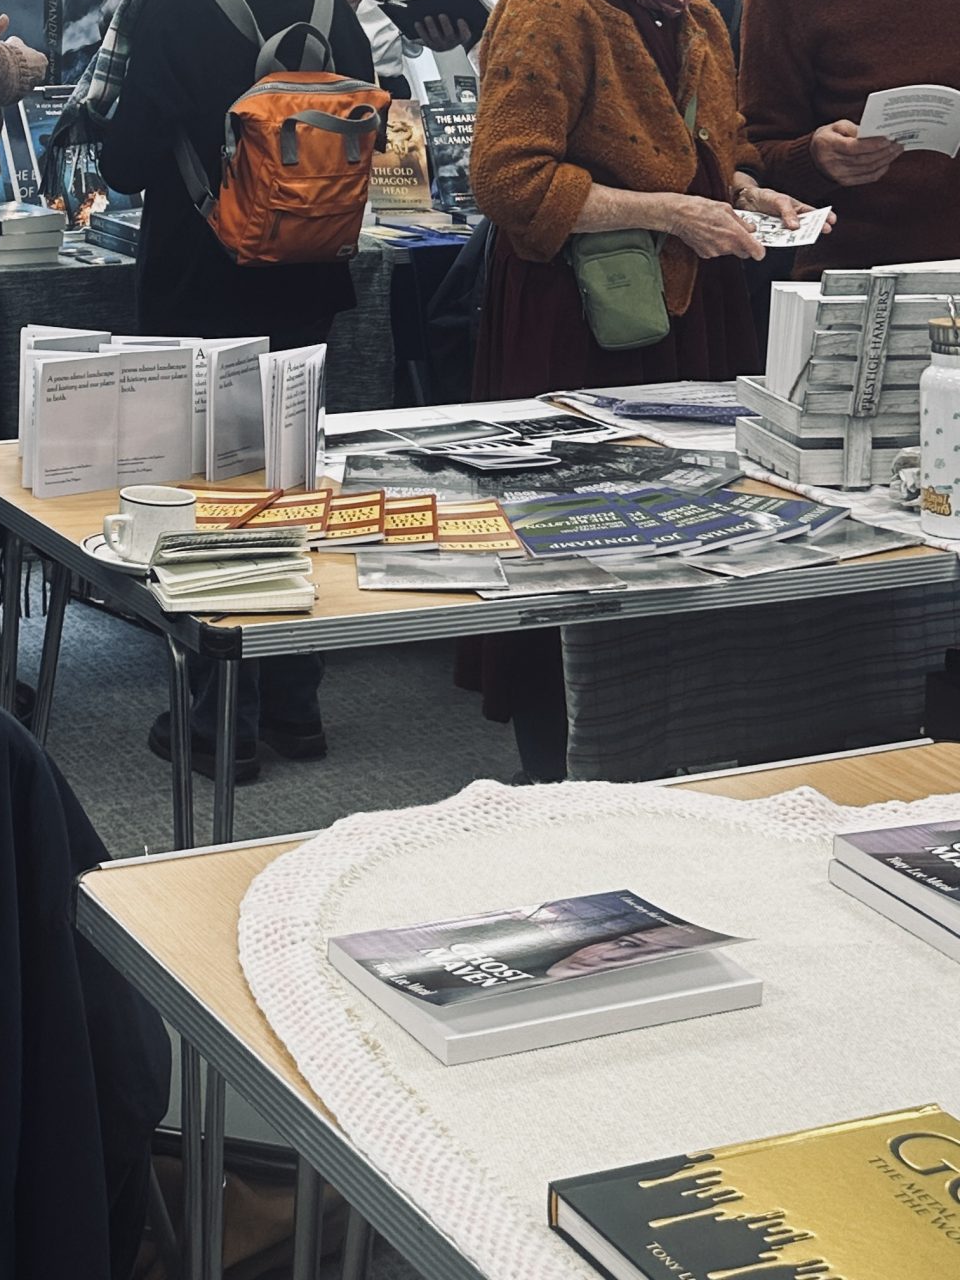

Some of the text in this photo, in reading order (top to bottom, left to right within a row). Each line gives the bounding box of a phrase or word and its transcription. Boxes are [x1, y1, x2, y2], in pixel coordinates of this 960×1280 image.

[435, 114, 452, 124] THE
[433, 134, 474, 146] SALAMAN
[14, 170, 29, 181] HE
[372, 167, 414, 176] THE OLD
[370, 176, 418, 186] DRAGON'S
[861, 290, 890, 412] PRESTIGE HAMPERS
[549, 534, 639, 550] JON HAMP
[449, 943, 536, 983] GHOST
[868, 1155, 957, 1221] THE METAL
[893, 1190, 931, 1217] THE
[645, 1240, 684, 1271] TONY
